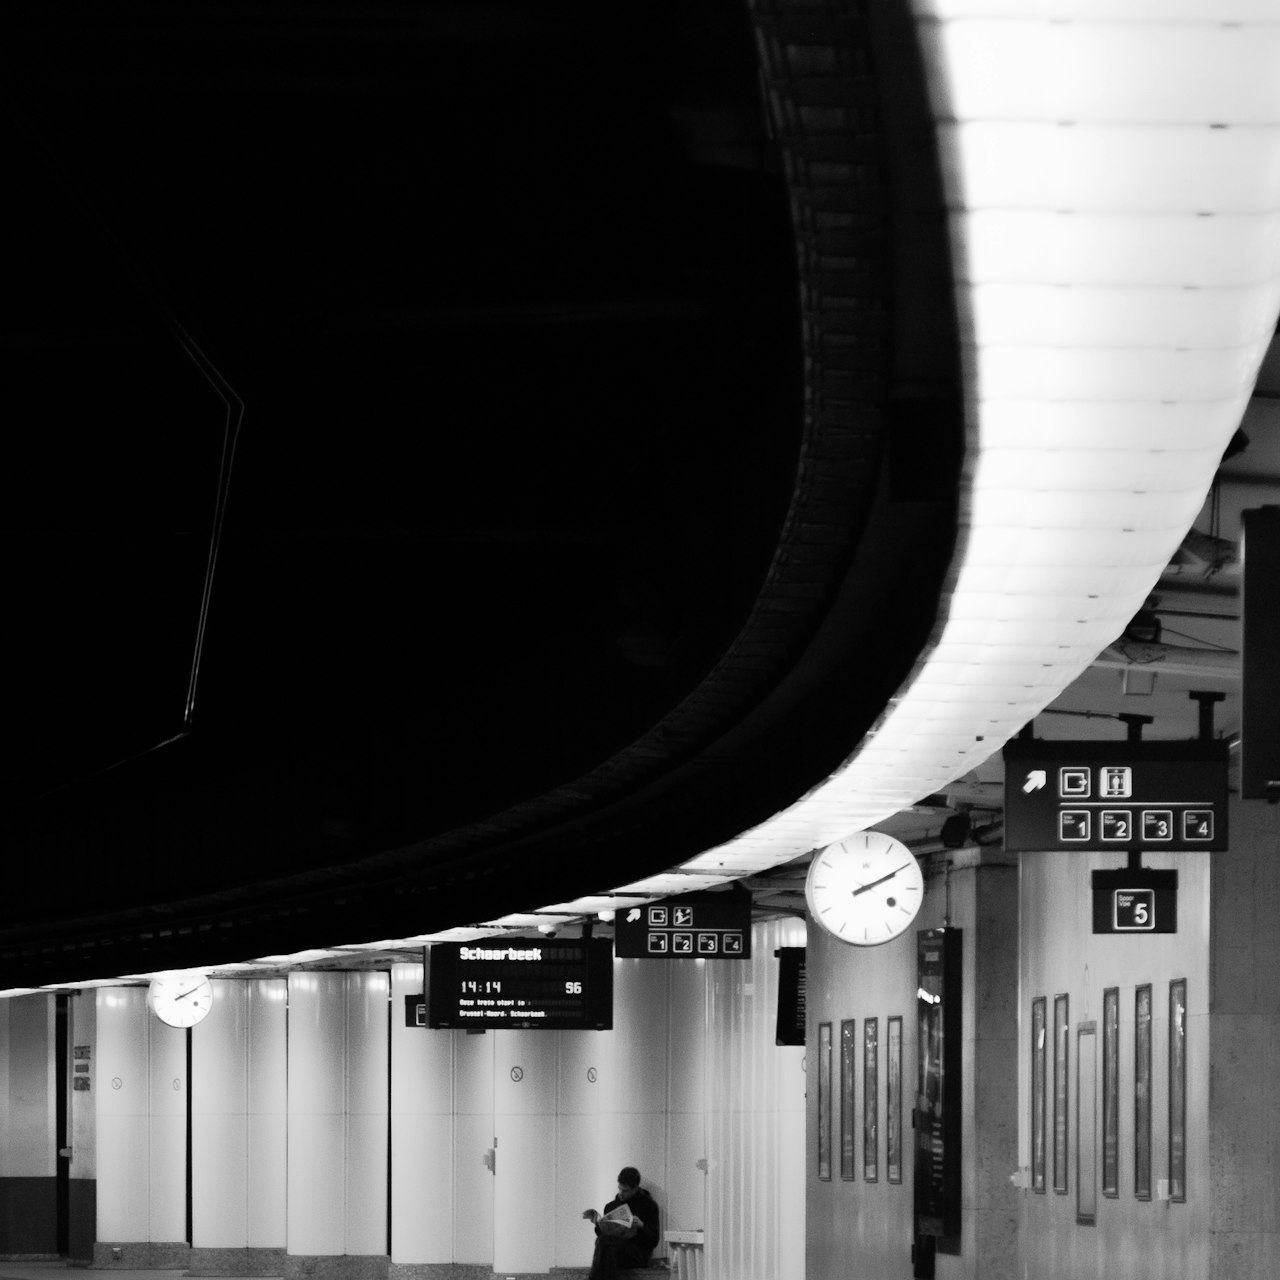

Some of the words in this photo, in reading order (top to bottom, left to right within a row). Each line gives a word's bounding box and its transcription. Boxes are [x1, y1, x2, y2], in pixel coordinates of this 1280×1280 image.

[1078, 821, 1086, 836] 1
[1116, 820, 1127, 837] 2
[1158, 820, 1168, 836] 3
[1198, 821, 1209, 836] 4
[1135, 902, 1148, 924] 5
[459, 946, 542, 961] Schaarbeek
[658, 940, 666, 952] 1
[682, 940, 691, 953] 2
[706, 941, 715, 953] 3
[731, 941, 740, 953] 4
[461, 981, 501, 994] 14:14
[565, 981, 582, 994] S6
